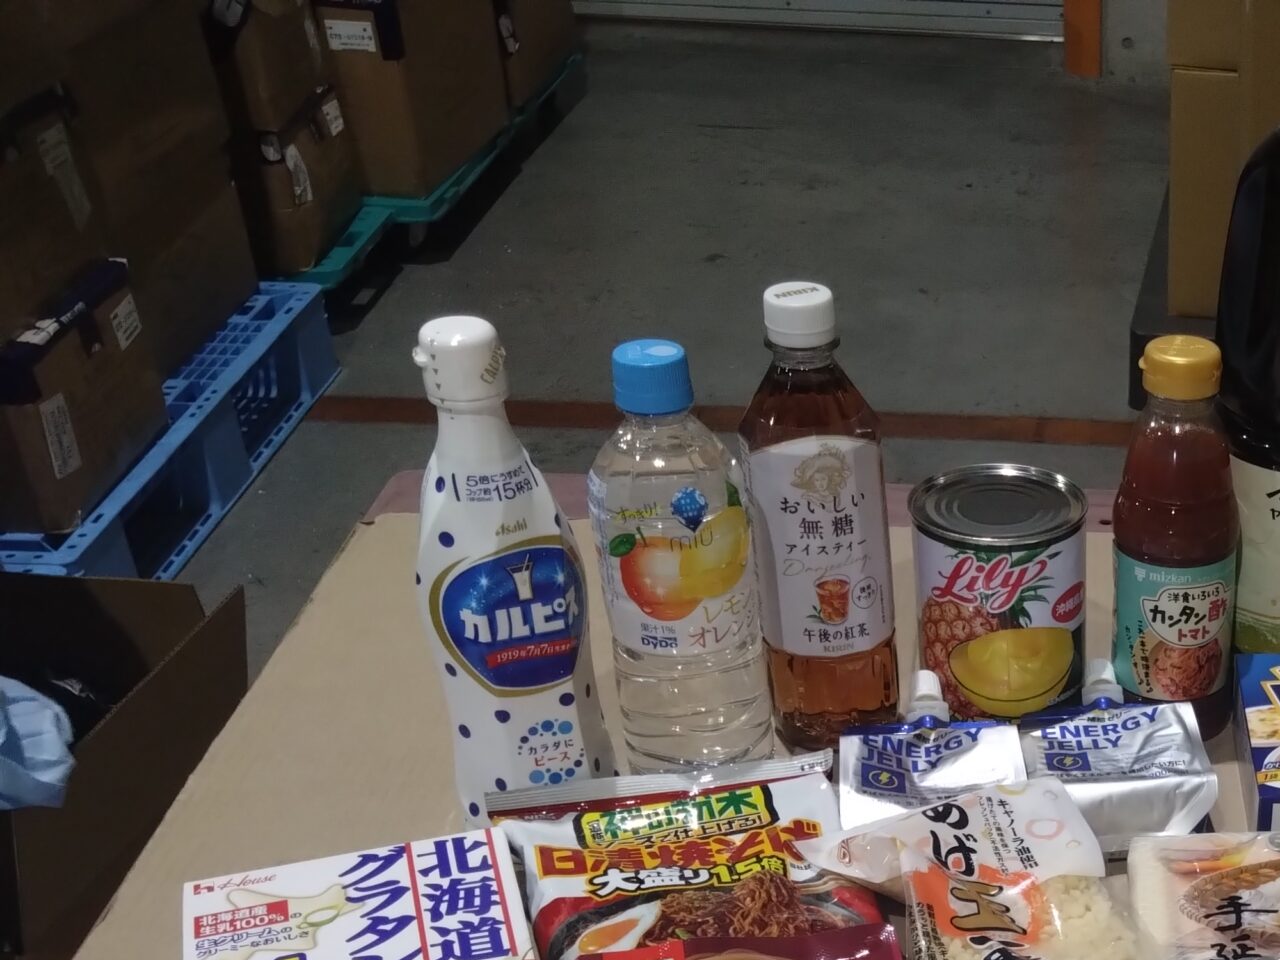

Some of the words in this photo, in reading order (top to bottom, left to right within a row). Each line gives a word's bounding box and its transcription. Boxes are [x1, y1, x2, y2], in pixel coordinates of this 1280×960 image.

[773, 286, 819, 300] KIRIN
[780, 493, 865, 514] おいしい
[495, 518, 528, 536] Asahi
[799, 514, 854, 540] 無糖
[785, 539, 867, 556] アイスティー
[931, 555, 1048, 611] Lily
[1150, 572, 1192, 583] mizkan
[1168, 587, 1220, 604] 洋食いろいろ
[1150, 598, 1228, 628] カンタン酢
[641, 635, 678, 648] DyDo
[803, 623, 870, 643] 午後の紅茶
[1178, 626, 1210, 642] トマト
[1041, 706, 1160, 741] ENERGY
[528, 739, 575, 755] カラダに
[862, 727, 983, 762] ENERGY
[1045, 735, 1124, 751] JELLY
[533, 752, 571, 767] ピース
[862, 747, 942, 775] JELLY
[537, 819, 820, 878] 日清焼そば
[590, 856, 787, 896] 大盛り1.5倍
[198, 904, 268, 926] 北海道産
[199, 911, 285, 937] 生乳100%
[195, 925, 294, 951] 生クリームの
